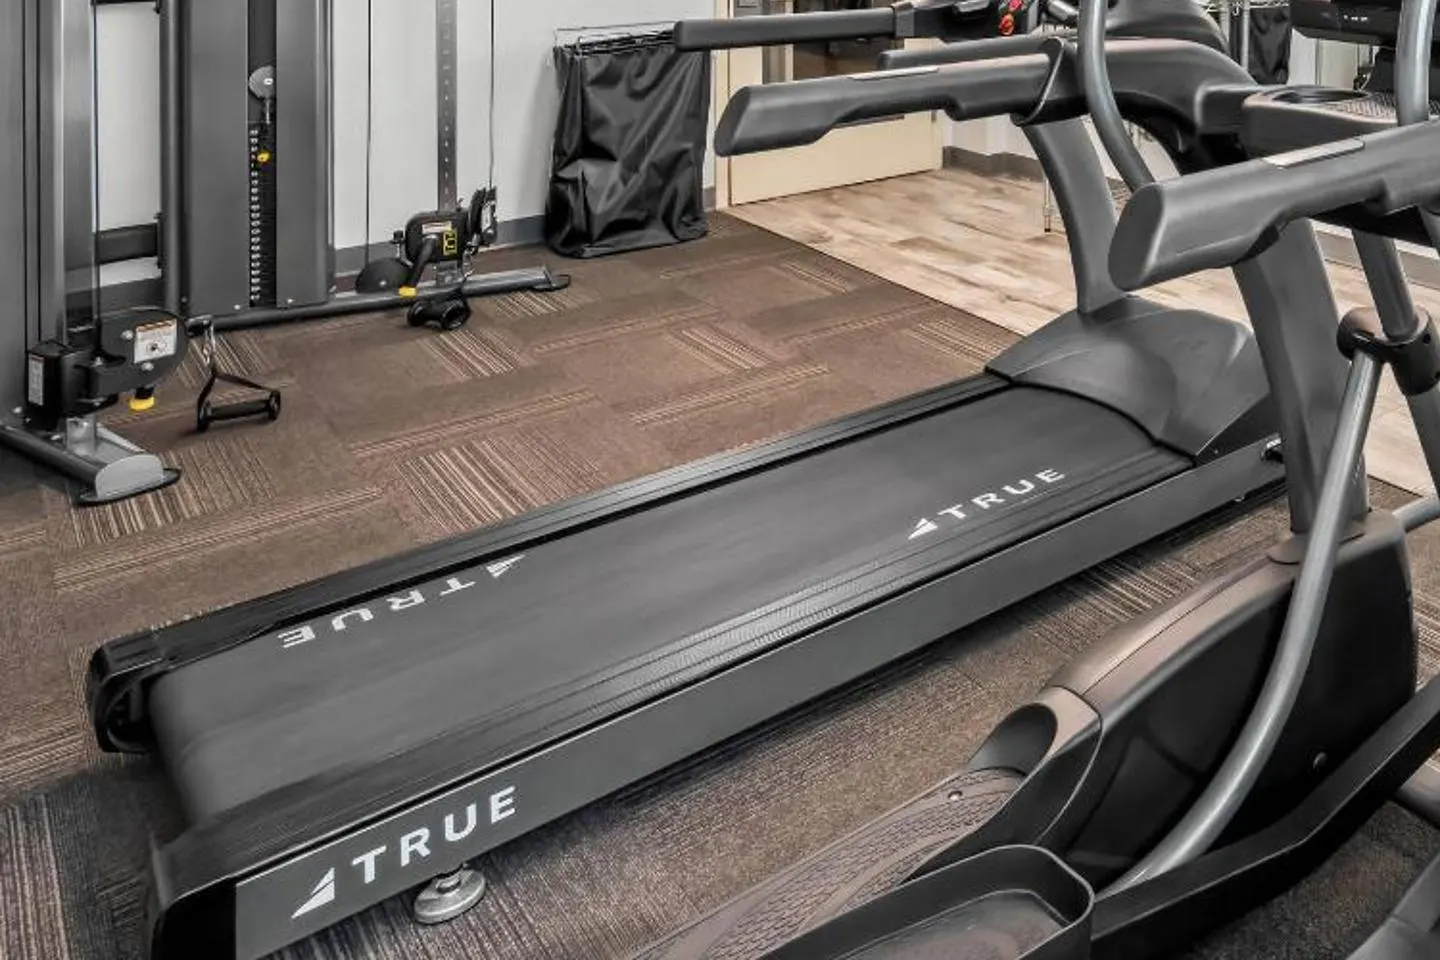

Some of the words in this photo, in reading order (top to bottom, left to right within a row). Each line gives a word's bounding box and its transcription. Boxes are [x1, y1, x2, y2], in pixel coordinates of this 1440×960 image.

[937, 468, 1065, 519] TRUE
[277, 577, 476, 648] TRUE
[352, 786, 516, 884] TRUE
